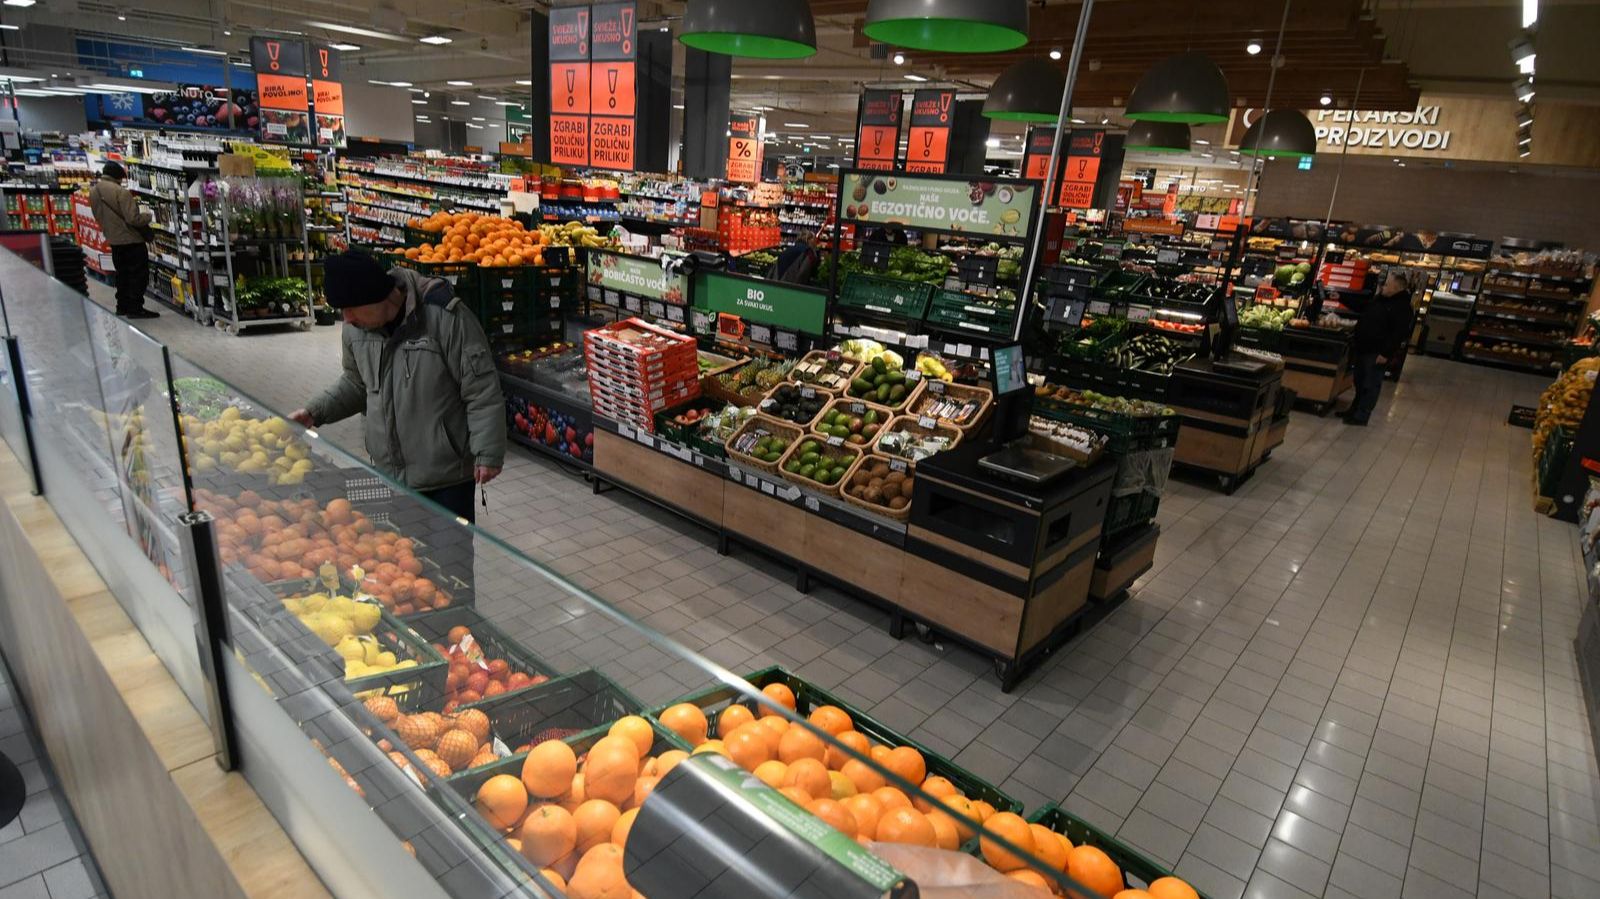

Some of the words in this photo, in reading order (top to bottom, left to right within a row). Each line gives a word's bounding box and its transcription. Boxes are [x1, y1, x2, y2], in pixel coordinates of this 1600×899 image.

[1317, 105, 1440, 126] PEKARSKI
[553, 120, 585, 134] ZGRABI
[594, 122, 631, 137] ZGRABI
[553, 134, 585, 146] ODLIČNU
[594, 137, 630, 150] ODLIČNU
[1315, 126, 1450, 150] PROIZVODI
[554, 146, 585, 159] PRILIKU!
[594, 149, 630, 163] PRILIKU!
[871, 200, 945, 219] EGZOTIČNO
[747, 288, 765, 301] BIO
